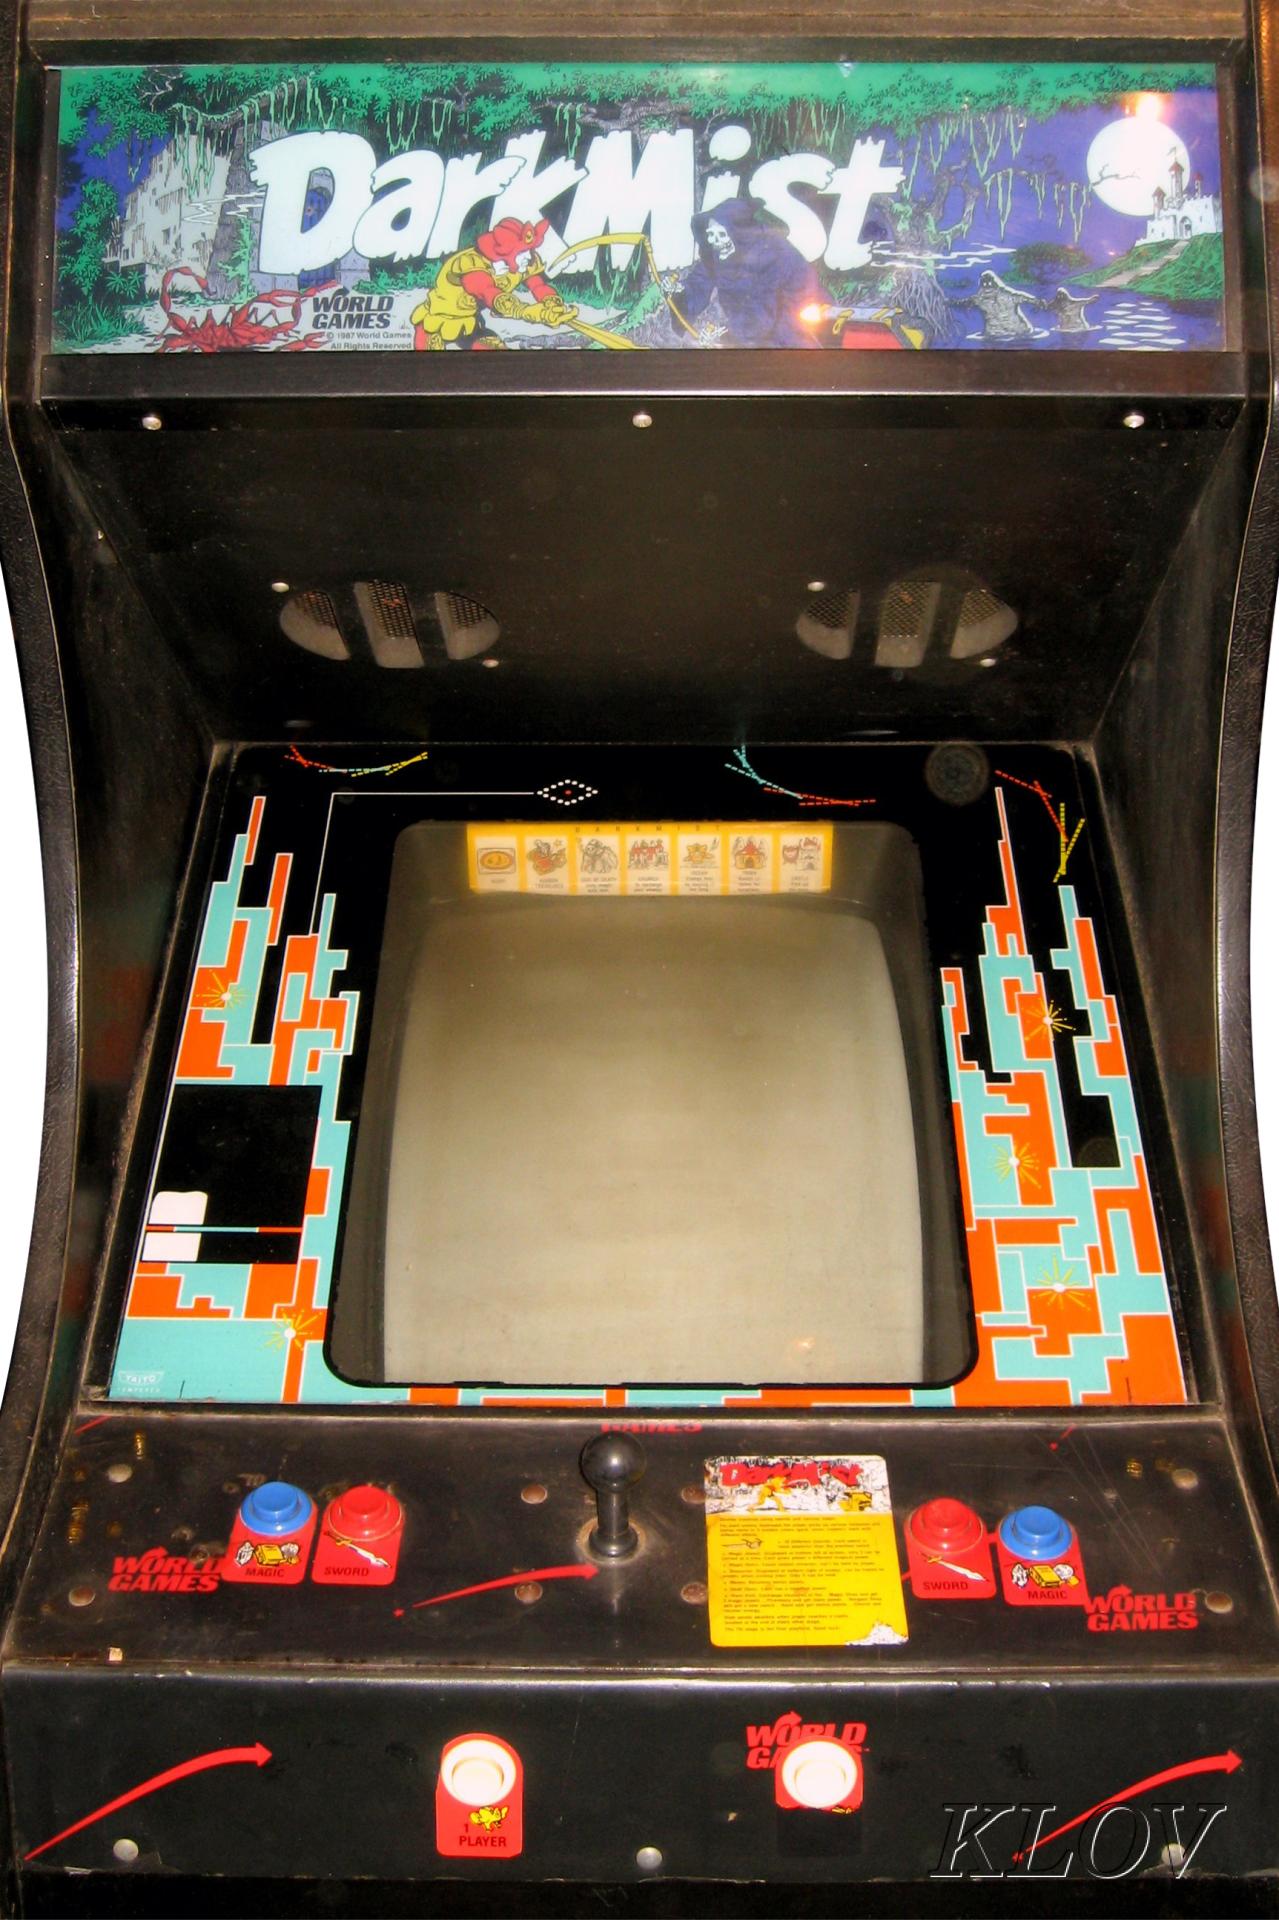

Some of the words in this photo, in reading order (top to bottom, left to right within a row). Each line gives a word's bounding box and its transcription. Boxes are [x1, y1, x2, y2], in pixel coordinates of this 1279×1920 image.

[312, 291, 394, 312] WORLD
[312, 313, 391, 329] GAMES
[337, 331, 354, 339] 1987
[356, 331, 380, 339] World
[382, 331, 411, 339] Games
[330, 342, 341, 350] All
[344, 342, 370, 351] Rights
[372, 341, 412, 350] Reserved
[111, 1551, 225, 1574] WORLD
[245, 1567, 285, 1578] MAGIC
[323, 1566, 370, 1577] SWORD
[107, 1574, 220, 1593] GAMES
[923, 1581, 969, 1591] SWORD
[1027, 1590, 1068, 1600] MAGIC
[1085, 1589, 1197, 1612] WORLD
[1087, 1611, 1199, 1632] GAMES
[464, 1823, 469, 1833] 1
[459, 1835, 507, 1848] PLAYER
